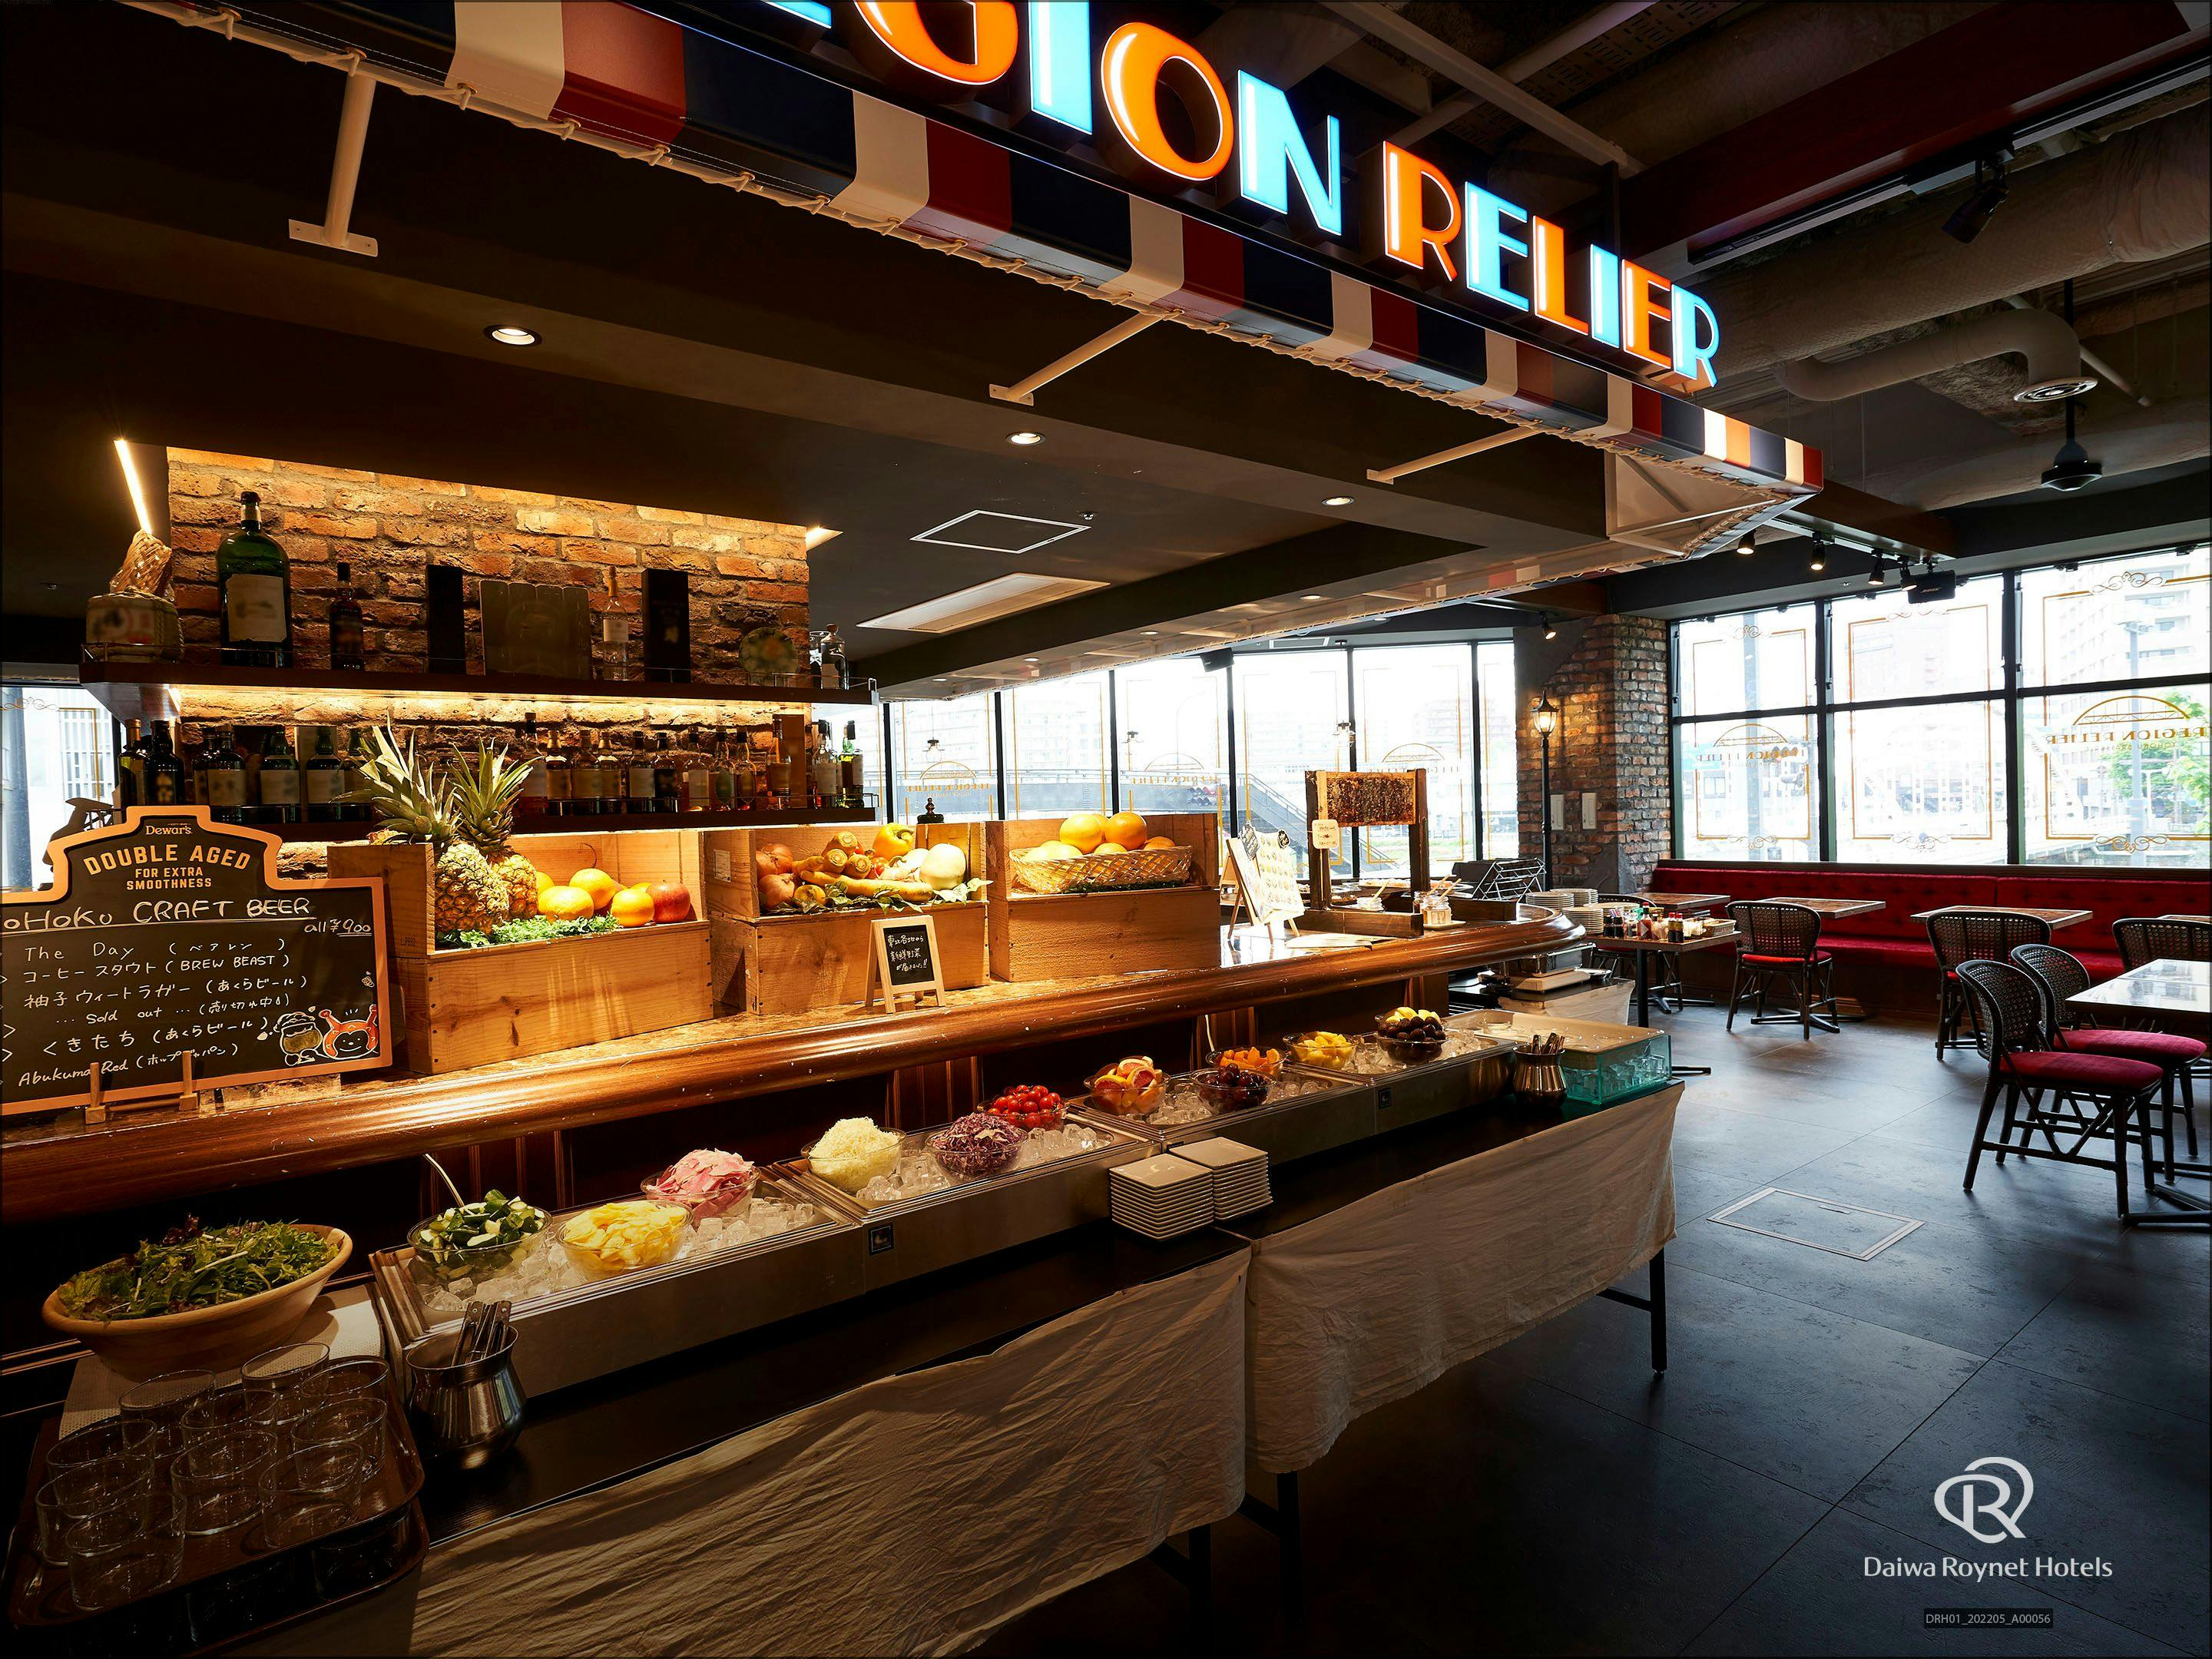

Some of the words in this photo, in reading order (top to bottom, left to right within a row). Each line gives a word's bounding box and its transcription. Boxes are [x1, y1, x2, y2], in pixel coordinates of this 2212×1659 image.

[1382, 140, 1720, 388] RELIER
[83, 844, 178, 876] DOUBLE
[190, 845, 250, 870] AGED
[135, 868, 159, 879] FOR
[164, 867, 204, 878] EXTRA
[127, 878, 212, 890] SMOOTHNESS
[133, 899, 234, 923] CRAFT
[247, 897, 310, 918] BEER
[25, 946, 65, 962] The
[93, 942, 134, 961] Day
[101, 1059, 129, 1075] Red
